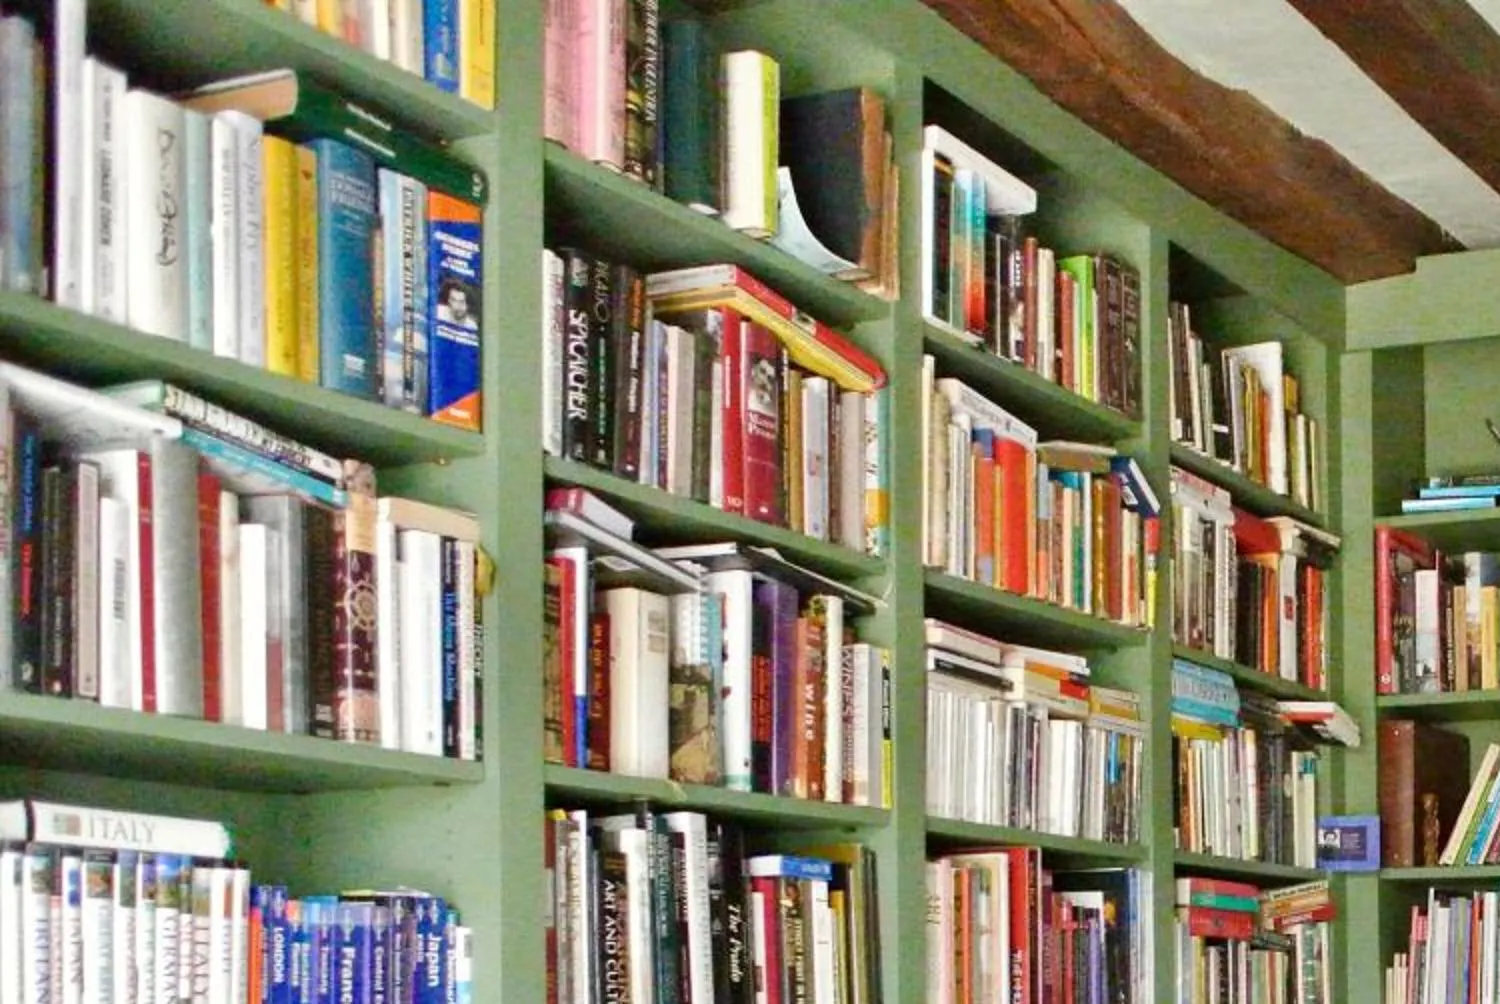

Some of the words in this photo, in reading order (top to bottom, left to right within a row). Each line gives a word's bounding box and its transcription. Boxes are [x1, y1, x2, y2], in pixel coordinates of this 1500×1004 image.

[568, 308, 589, 422] SPYCATCHER
[89, 811, 156, 843] ITALY
[604, 879, 618, 911] ART
[604, 915, 618, 954] AND
[728, 904, 742, 932] The
[192, 924, 210, 999] ITALY
[274, 926, 286, 983] LONDON
[427, 932, 443, 987] Japan
[729, 938, 743, 983] Prado
